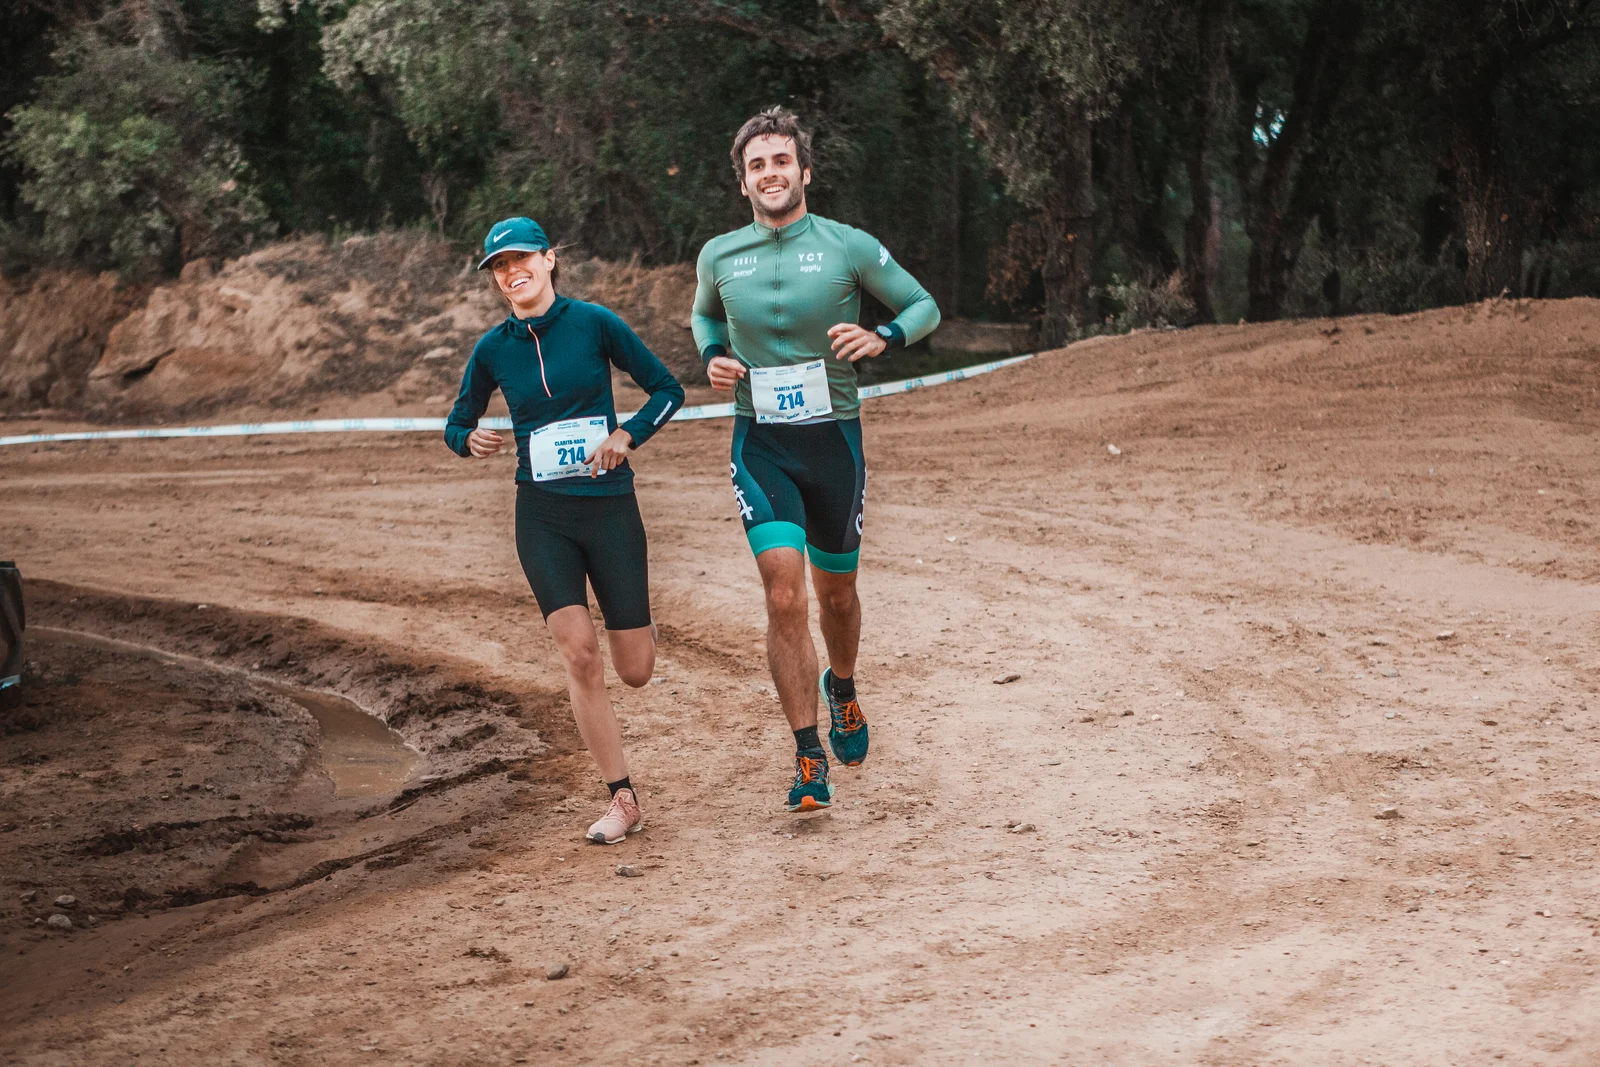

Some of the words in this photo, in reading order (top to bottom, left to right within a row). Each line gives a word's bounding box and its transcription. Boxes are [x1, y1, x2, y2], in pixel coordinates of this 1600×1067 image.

[798, 252, 824, 262] YCT
[776, 390, 805, 411] 214
[557, 446, 587, 466] 214
